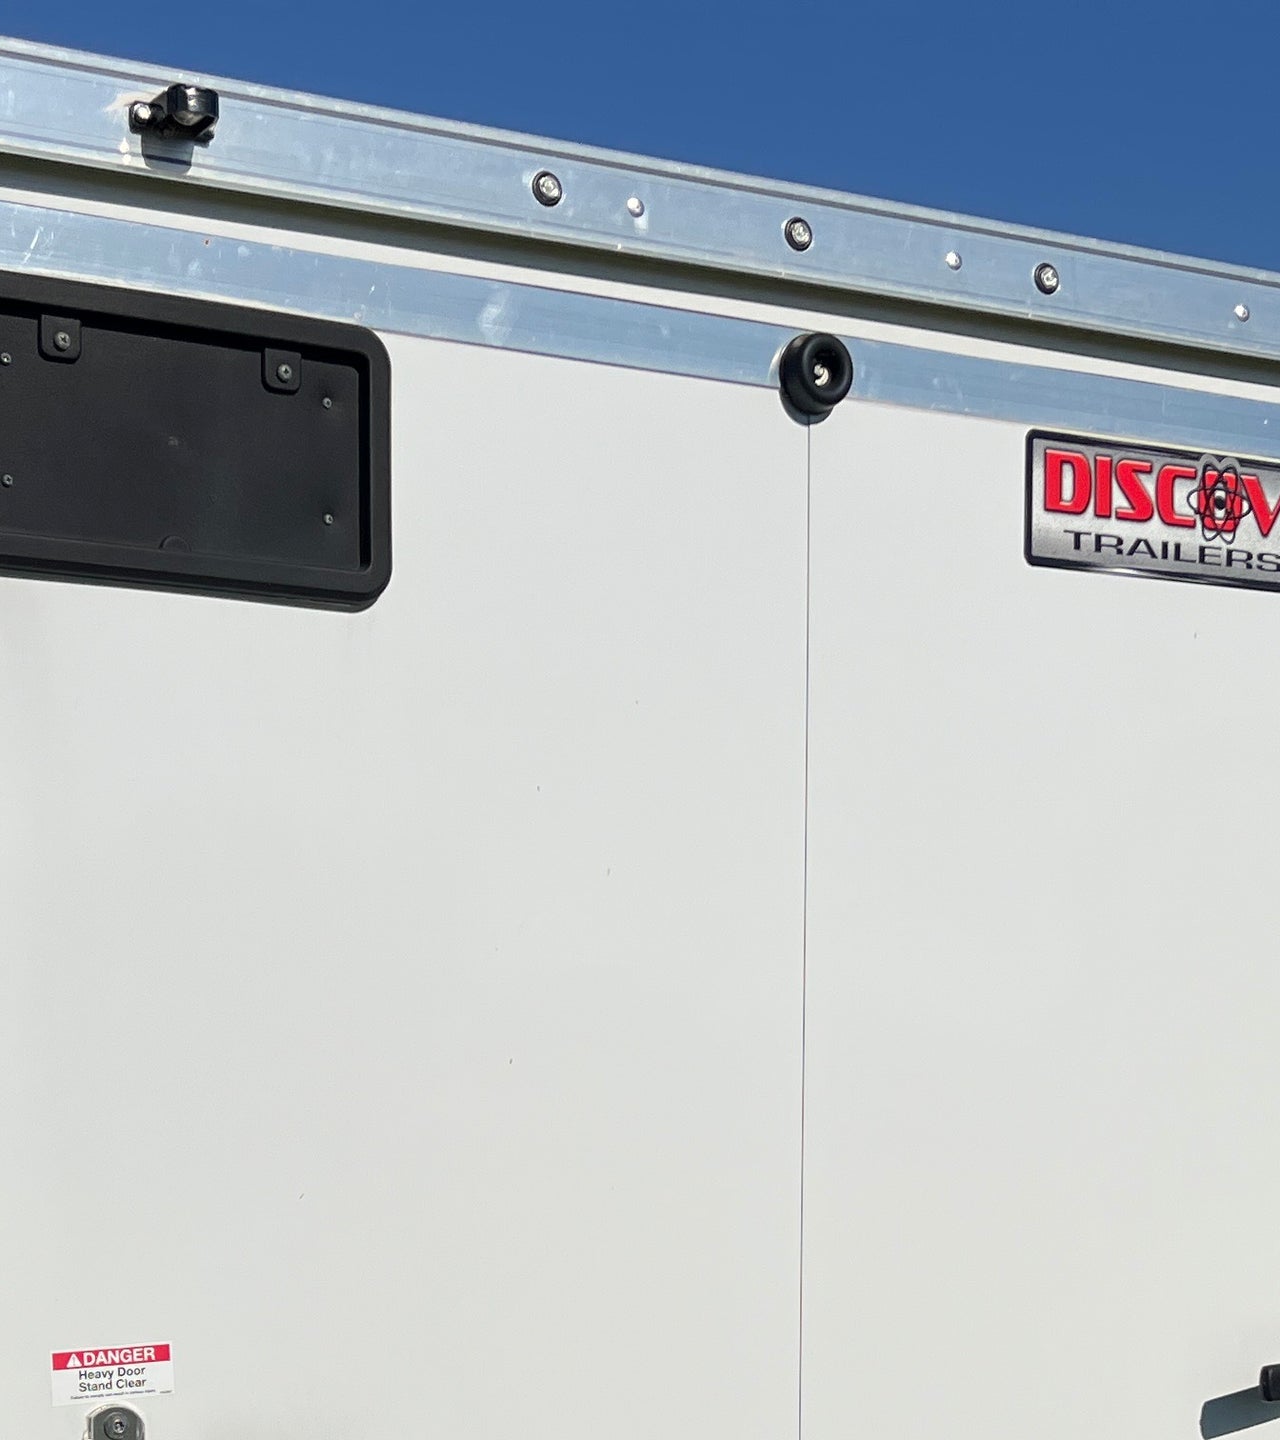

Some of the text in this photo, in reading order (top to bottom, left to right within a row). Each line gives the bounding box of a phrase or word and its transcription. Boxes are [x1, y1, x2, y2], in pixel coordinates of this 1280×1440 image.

[83, 1347, 156, 1366] DANGER
[78, 1367, 145, 1380] Heavy Door
[79, 1378, 146, 1392] Stand Clear
